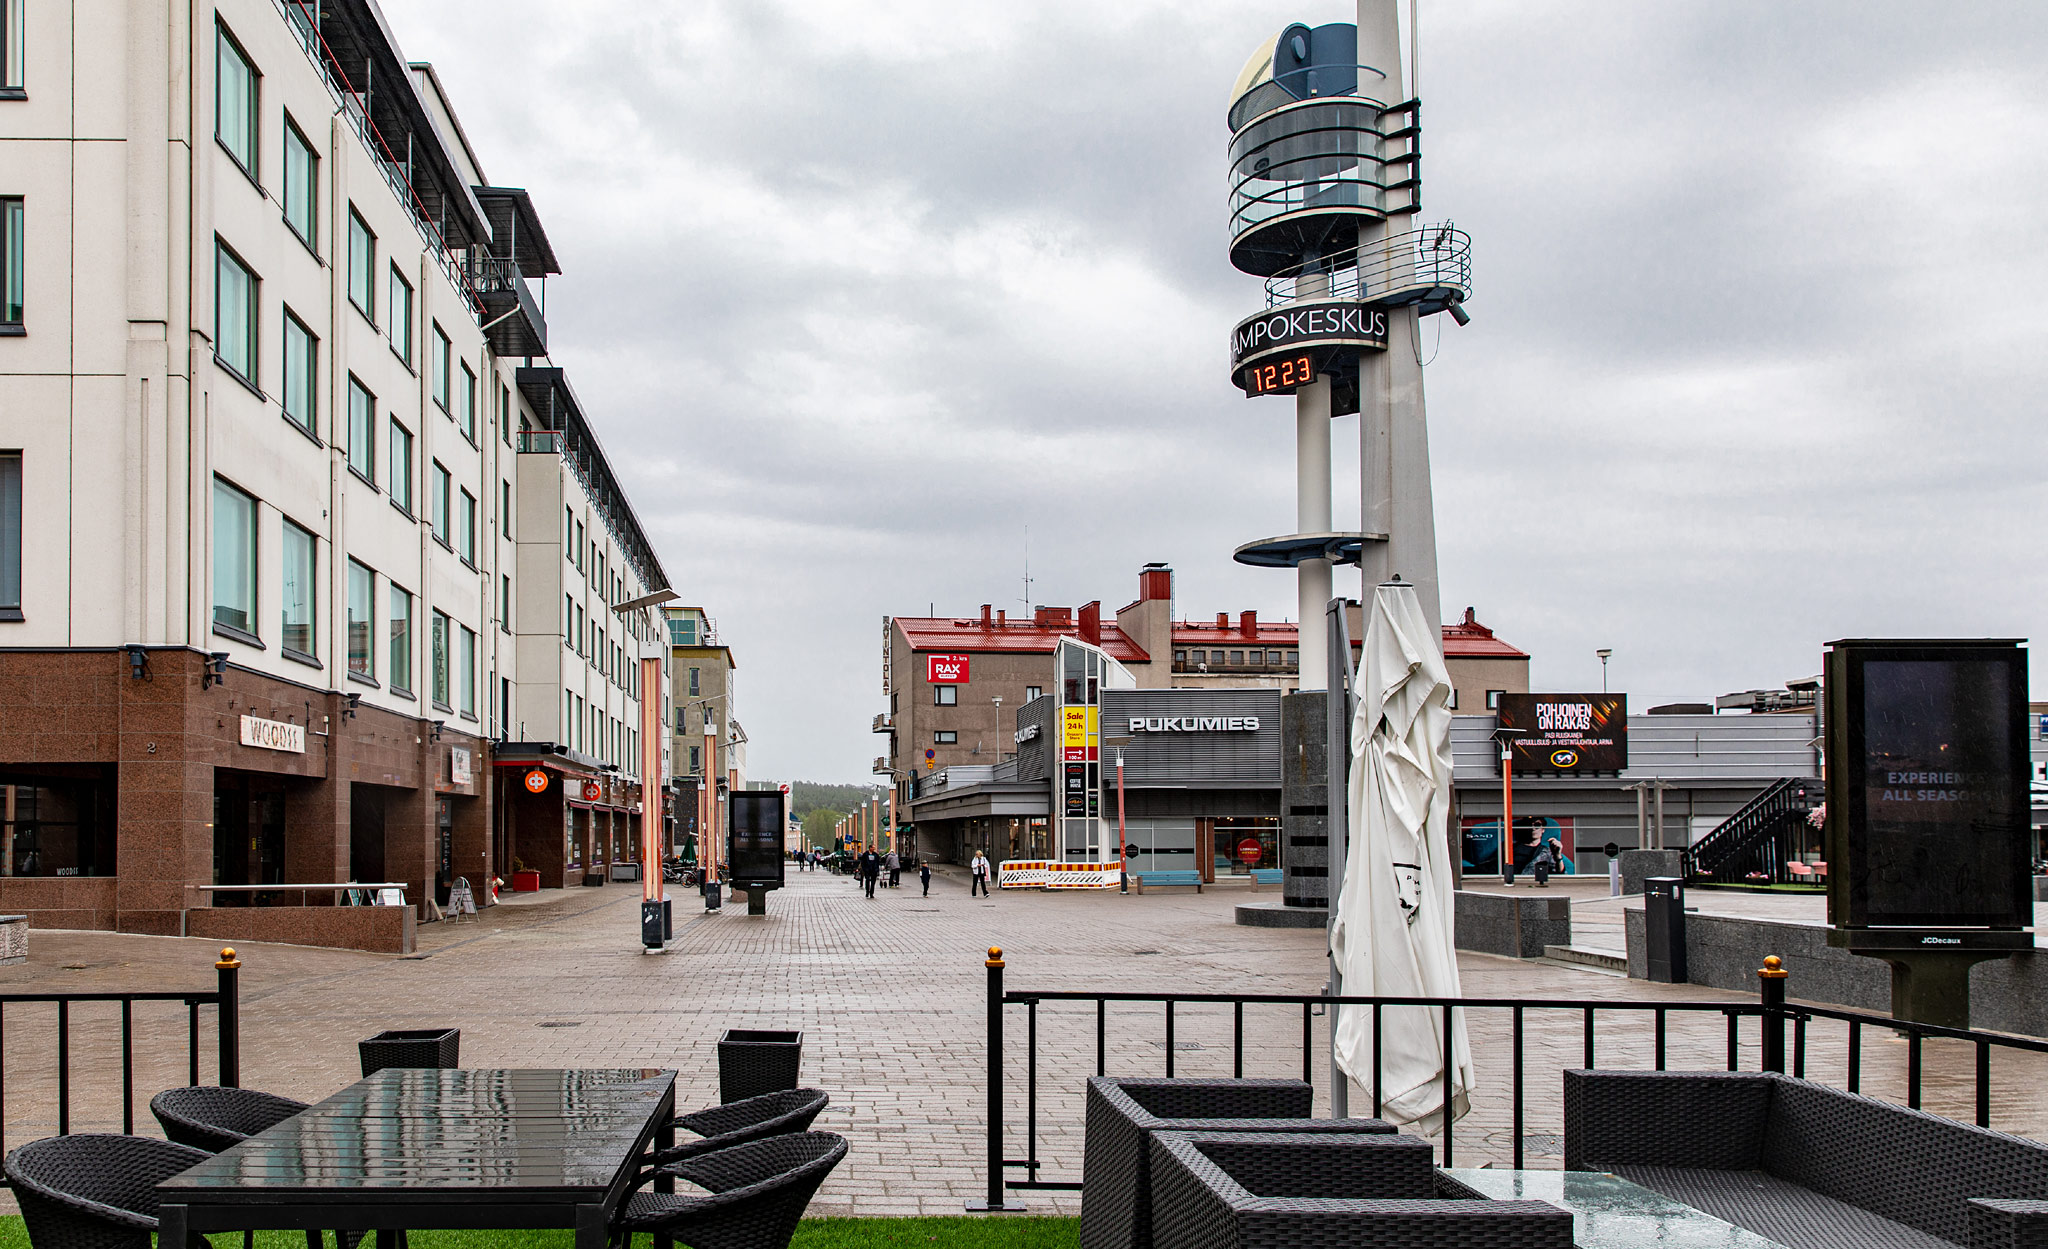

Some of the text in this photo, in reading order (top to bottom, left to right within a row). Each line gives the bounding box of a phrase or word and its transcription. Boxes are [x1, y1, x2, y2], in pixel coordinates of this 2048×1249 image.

[1253, 356, 1311, 392] 1223
[935, 664, 961, 674] RAX
[1536, 703, 1592, 718] POHJOINEN
[1128, 716, 1260, 732] PUKUMIES
[1538, 717, 1590, 730] ON RAKAS
[147, 741, 157, 753] 2
[1887, 772, 1985, 784] EXPERIEN
[1882, 789, 1912, 801] ALL
[1921, 936, 1962, 944] JCDecaux
